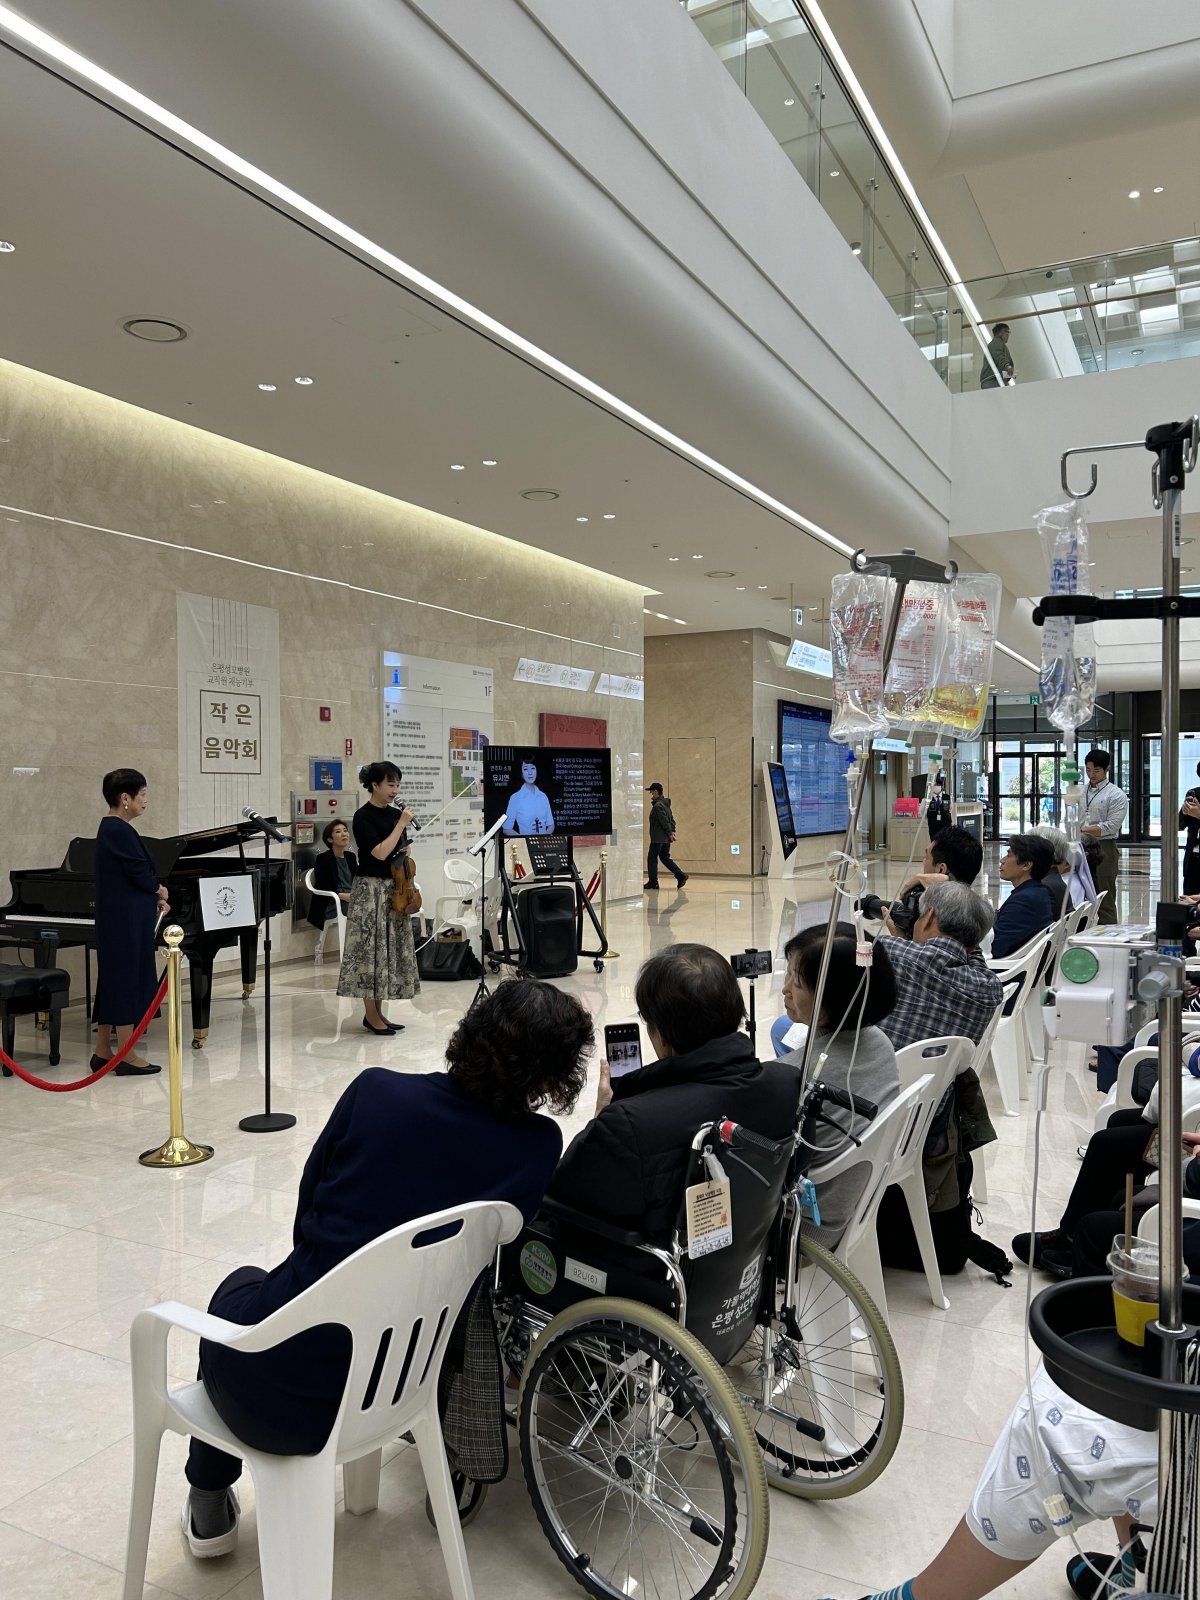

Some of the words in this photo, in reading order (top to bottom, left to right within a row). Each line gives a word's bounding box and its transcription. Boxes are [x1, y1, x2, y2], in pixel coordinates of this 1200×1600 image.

[212, 662, 250, 676] 은평성모병원
[484, 685, 492, 697] 1F
[203, 736, 258, 761] 음악회
[492, 774, 510, 782] 유시연
[531, 1244, 551, 1264] K300
